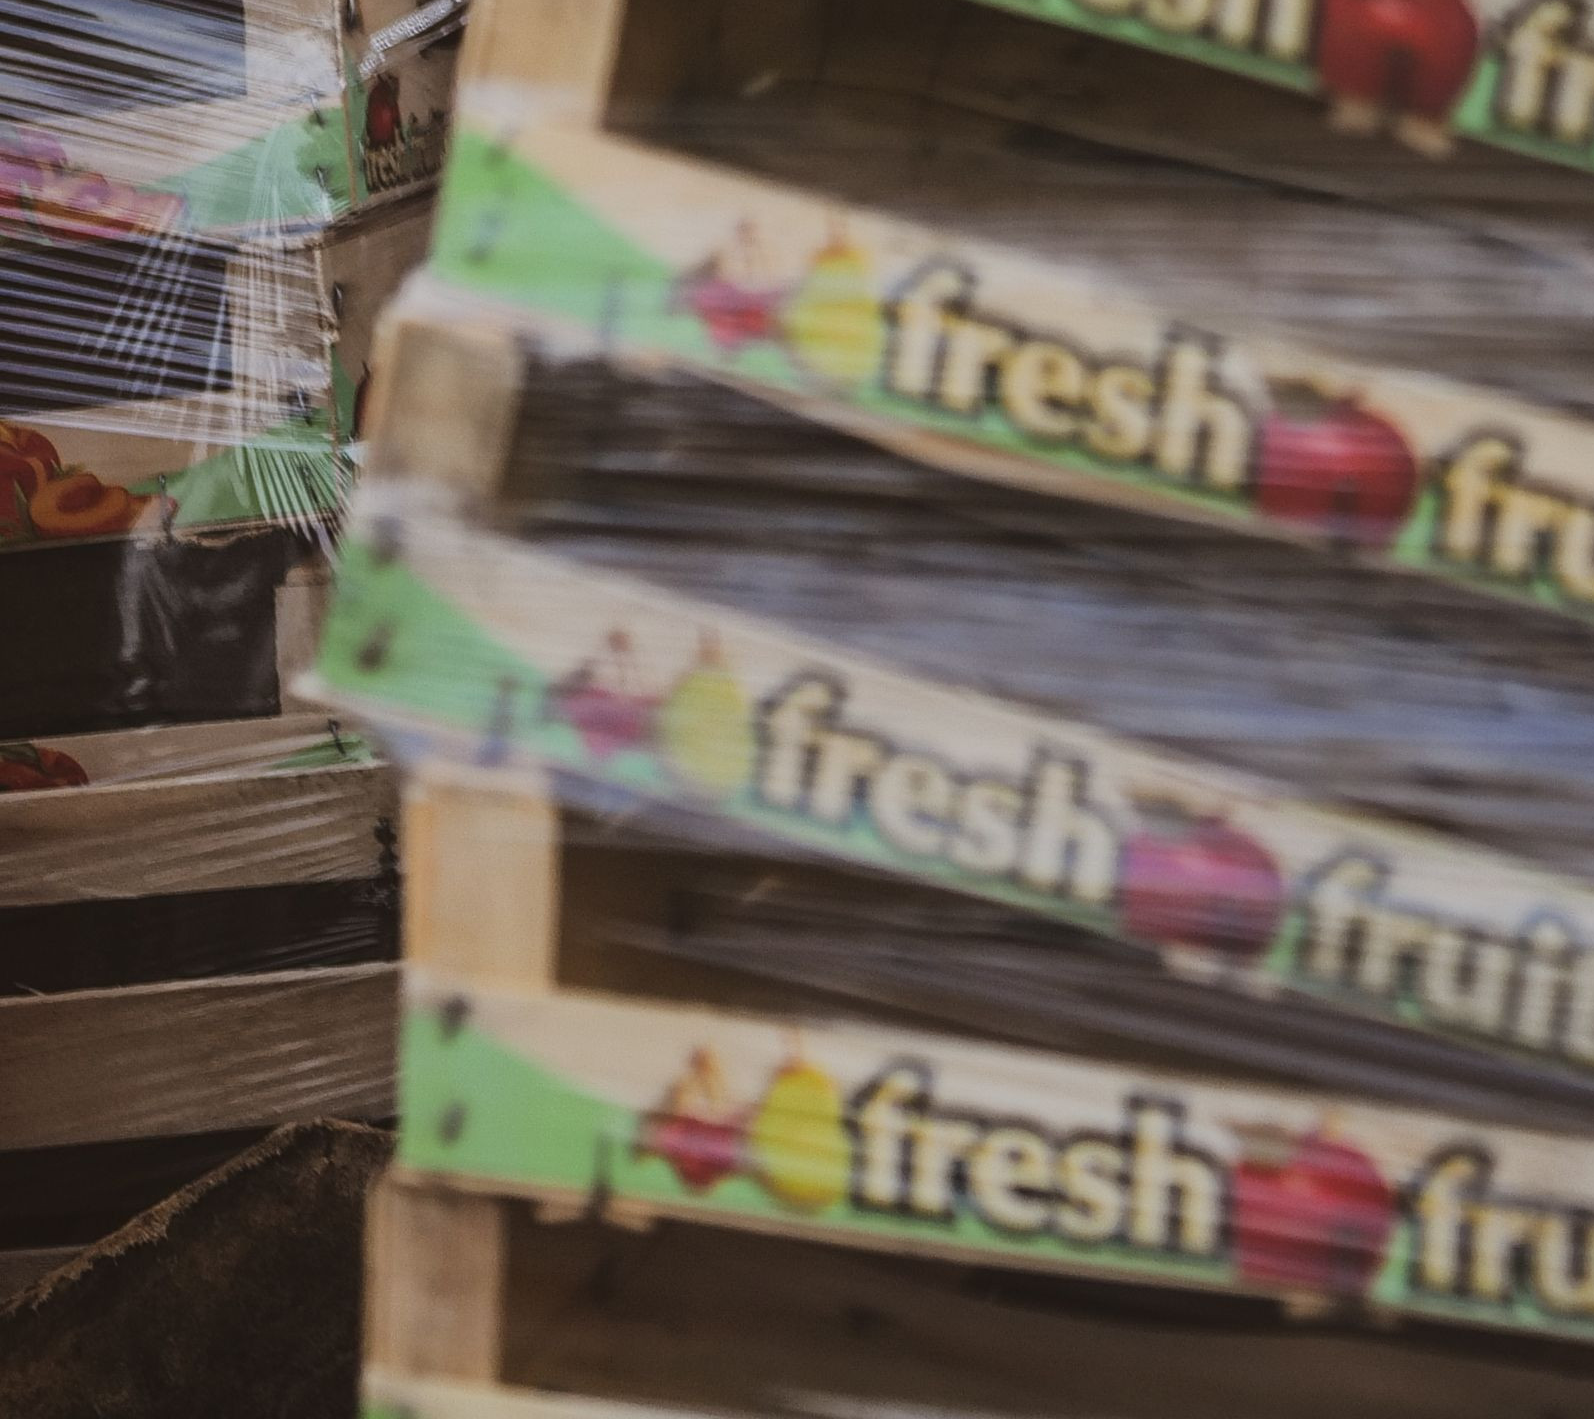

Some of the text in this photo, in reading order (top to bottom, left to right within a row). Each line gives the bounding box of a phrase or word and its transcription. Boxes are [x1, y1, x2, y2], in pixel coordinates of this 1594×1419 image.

[881, 258, 1257, 501] fresh
[750, 672, 1126, 908] fresh
[841, 1063, 1229, 1266] fresh
